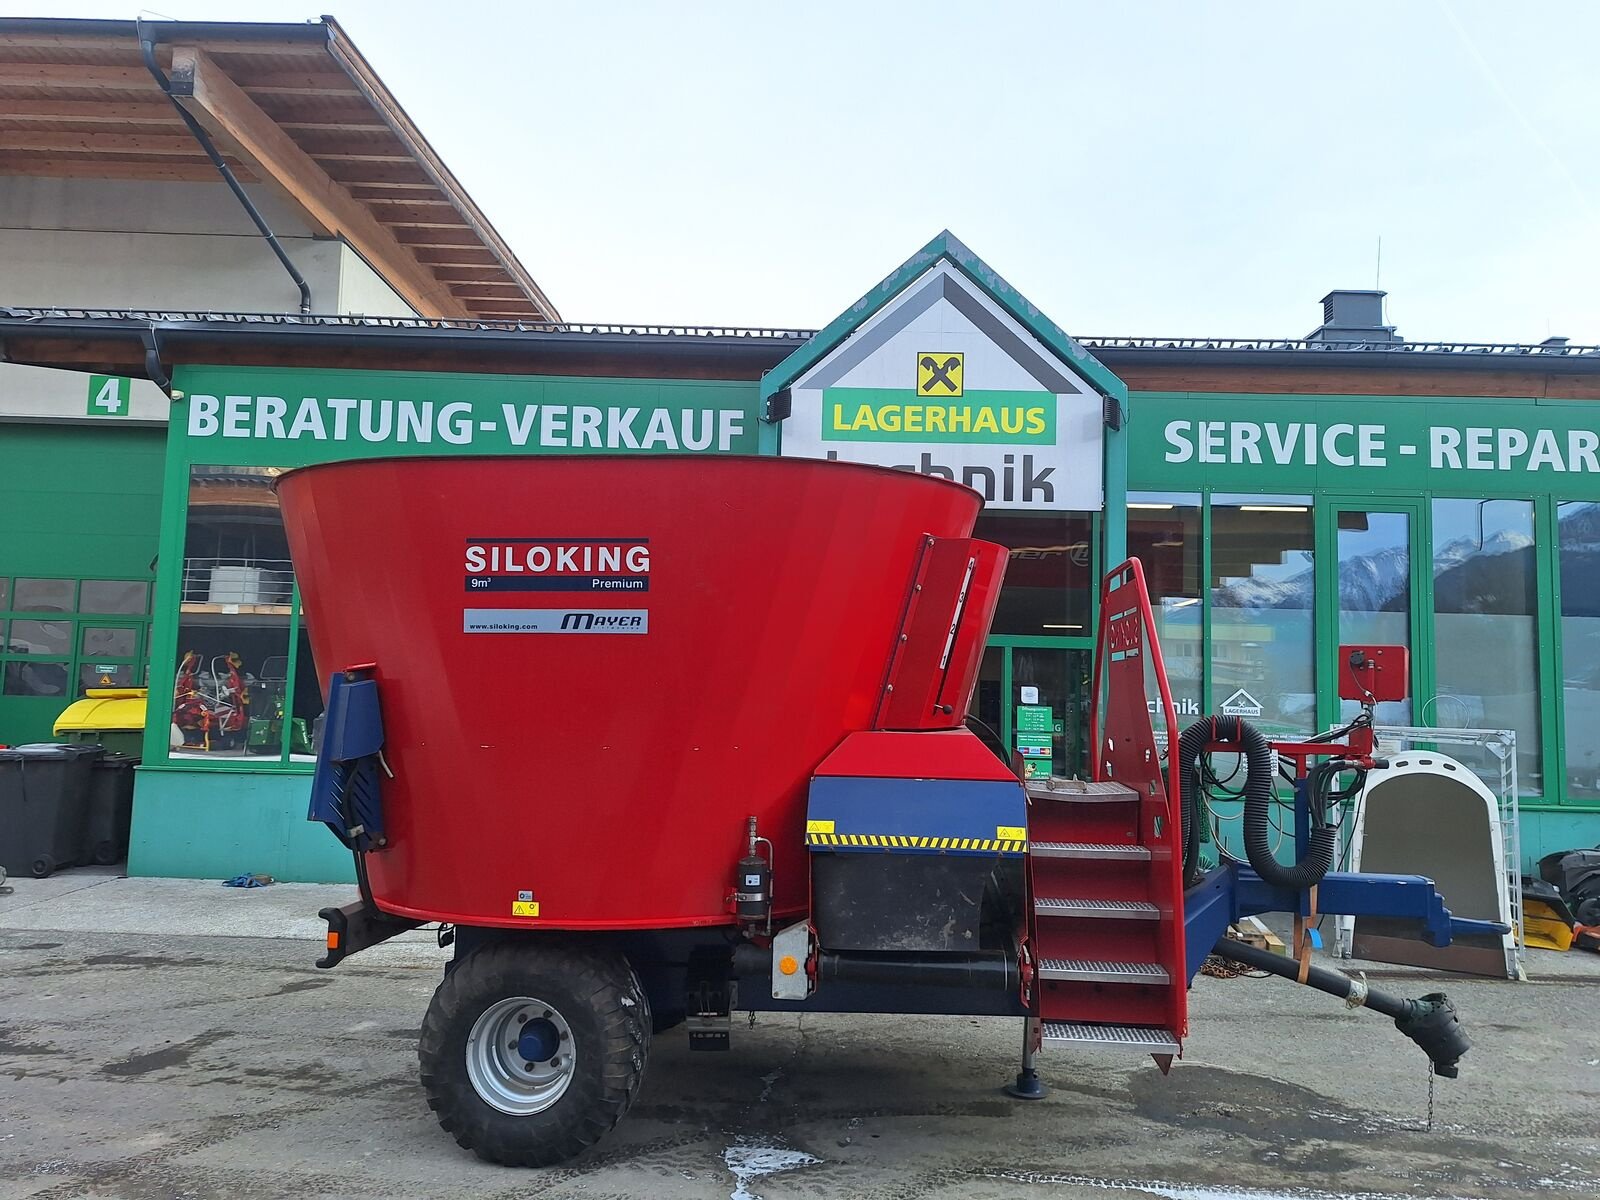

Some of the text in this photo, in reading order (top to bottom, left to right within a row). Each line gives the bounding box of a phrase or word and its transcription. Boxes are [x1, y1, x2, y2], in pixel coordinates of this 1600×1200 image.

[95, 378, 122, 413] 4
[187, 394, 745, 451] BERATUNG-VERKAUF
[833, 403, 1046, 435] LAGERHAUS
[1164, 420, 1387, 467] SERVICE
[1430, 426, 1600, 473] REPAR
[465, 545, 650, 573] SILOKING
[592, 578, 643, 589] Premium
[469, 623, 538, 631] www.siloking.com
[560, 613, 642, 630] MAYER
